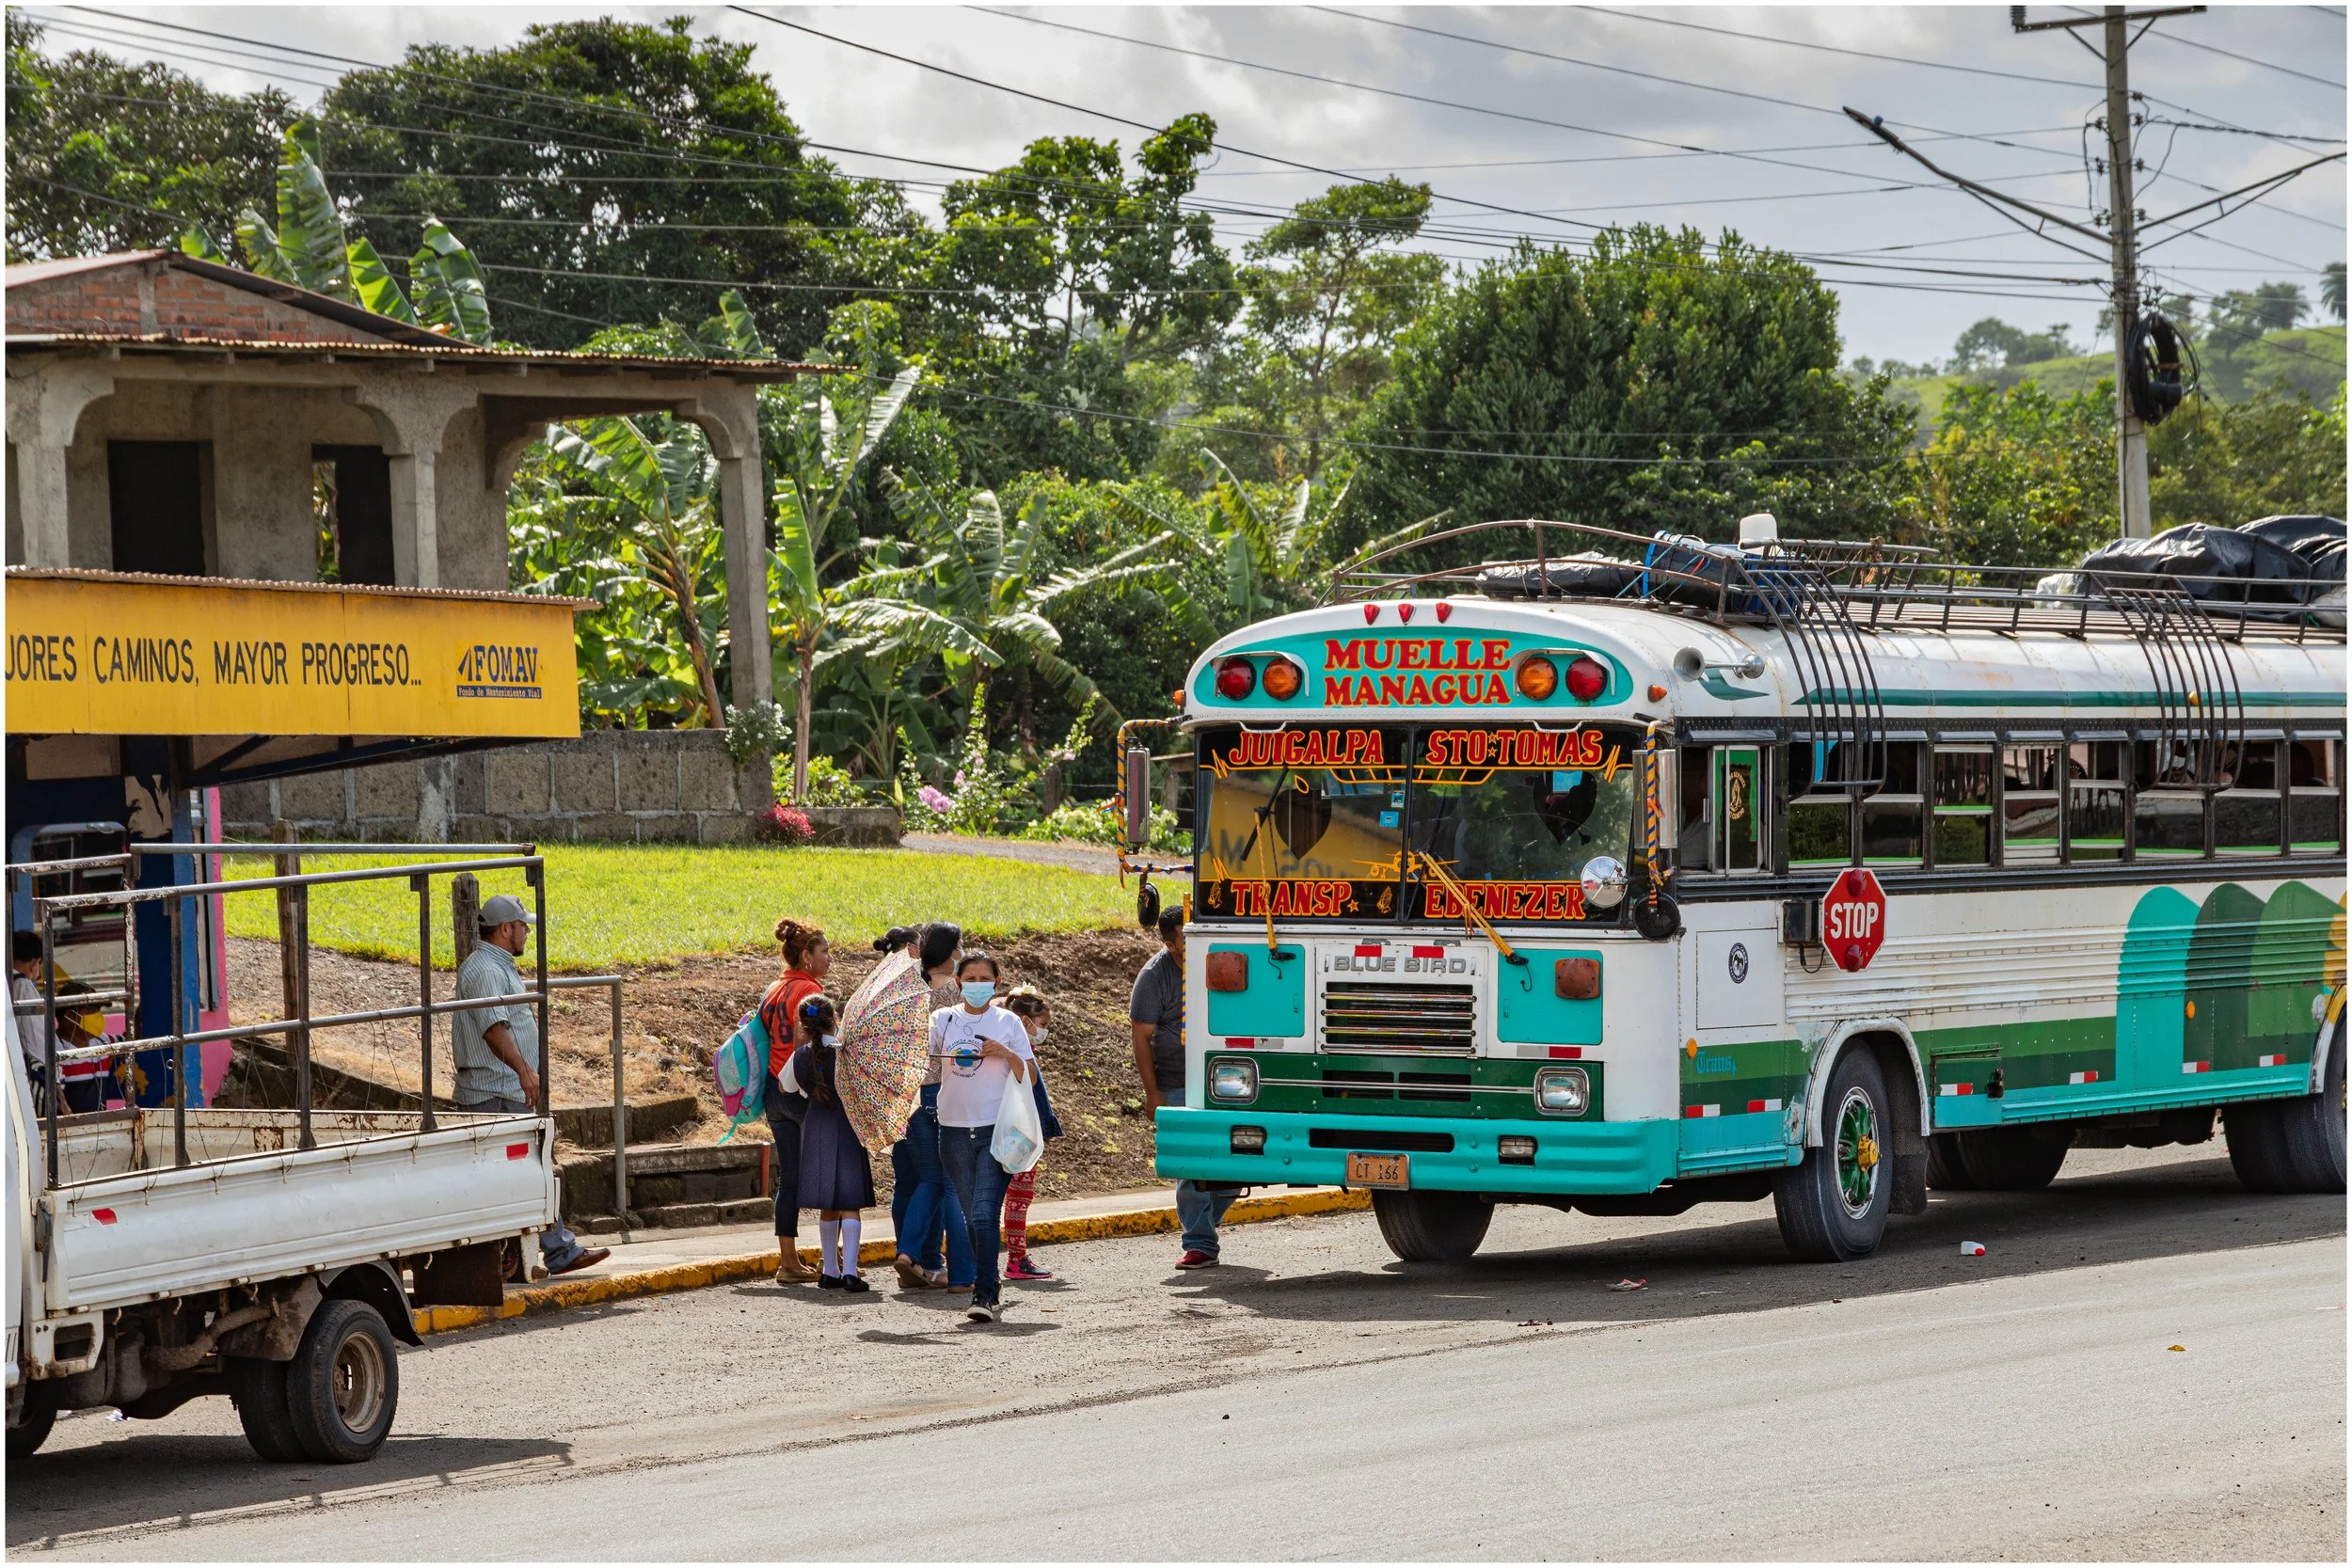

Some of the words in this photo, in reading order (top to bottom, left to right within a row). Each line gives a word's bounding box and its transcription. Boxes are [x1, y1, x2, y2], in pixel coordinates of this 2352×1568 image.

[5, 634, 77, 682] JORES
[93, 636, 199, 687] CAMINOS,
[213, 641, 289, 686] MAYOR
[301, 641, 421, 686] PROGRESO...
[473, 644, 538, 683] FOMAV
[1324, 639, 1511, 671] MUELLE
[458, 688, 475, 697] Fondo
[477, 688, 485, 697] de
[1324, 673, 1512, 706] MANAGUA
[1229, 730, 1384, 766] JUIGALPA
[1424, 883, 1586, 920] EBENEZER
[1830, 902, 1880, 939] STOP
[1333, 955, 1397, 973] BLUE
[1404, 957, 1467, 974] BIRD
[1356, 1163, 1370, 1179] CT
[1377, 1164, 1400, 1180] 166
